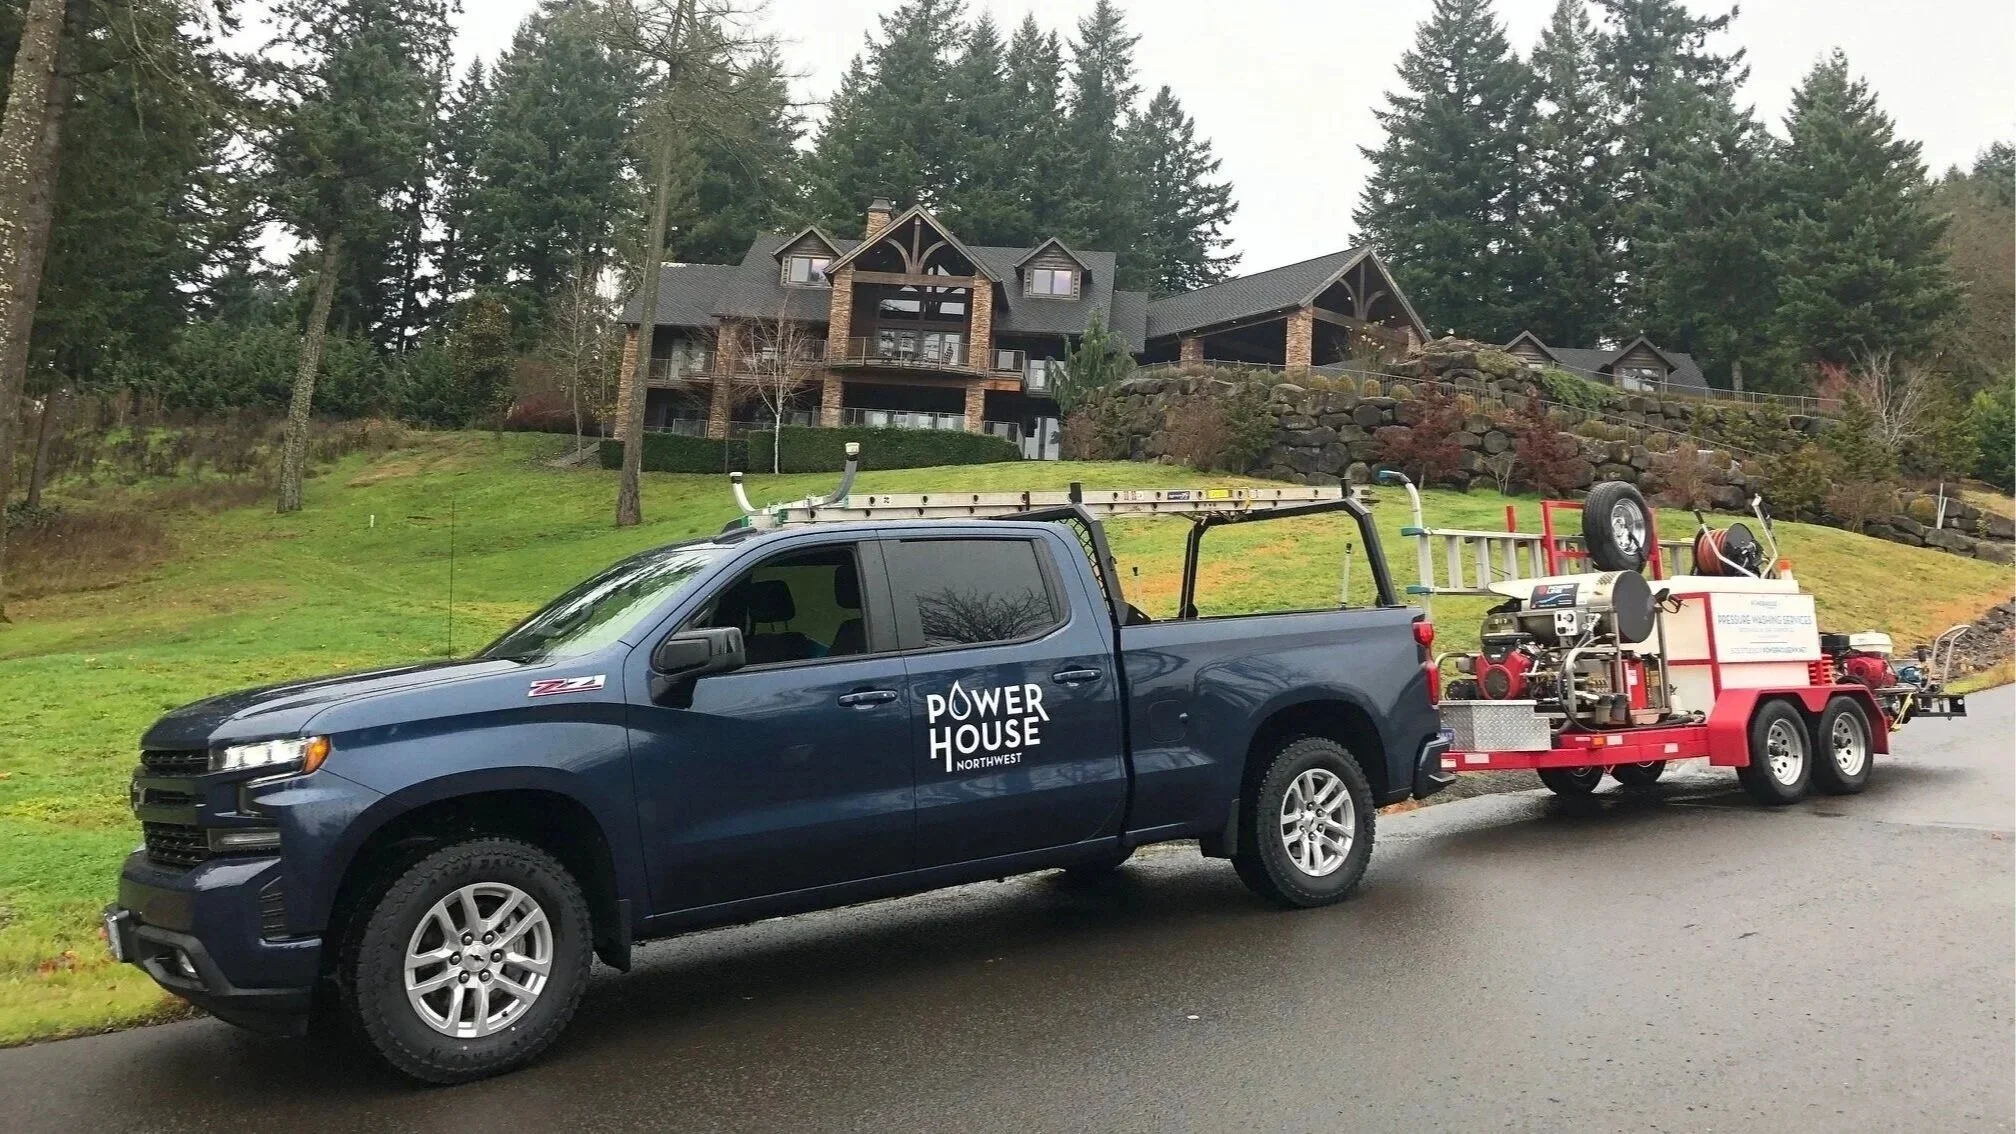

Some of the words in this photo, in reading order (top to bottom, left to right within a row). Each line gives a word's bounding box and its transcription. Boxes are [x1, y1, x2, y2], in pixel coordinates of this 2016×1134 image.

[1717, 614, 1751, 625] PRESSURE
[1752, 615, 1782, 625] WASHING
[1783, 615, 1812, 625] SERVICES
[528, 674, 606, 697] Z71
[926, 680, 1050, 724] POWER
[929, 716, 1041, 773] HOUSE
[956, 752, 1022, 772] NORTHWEST
